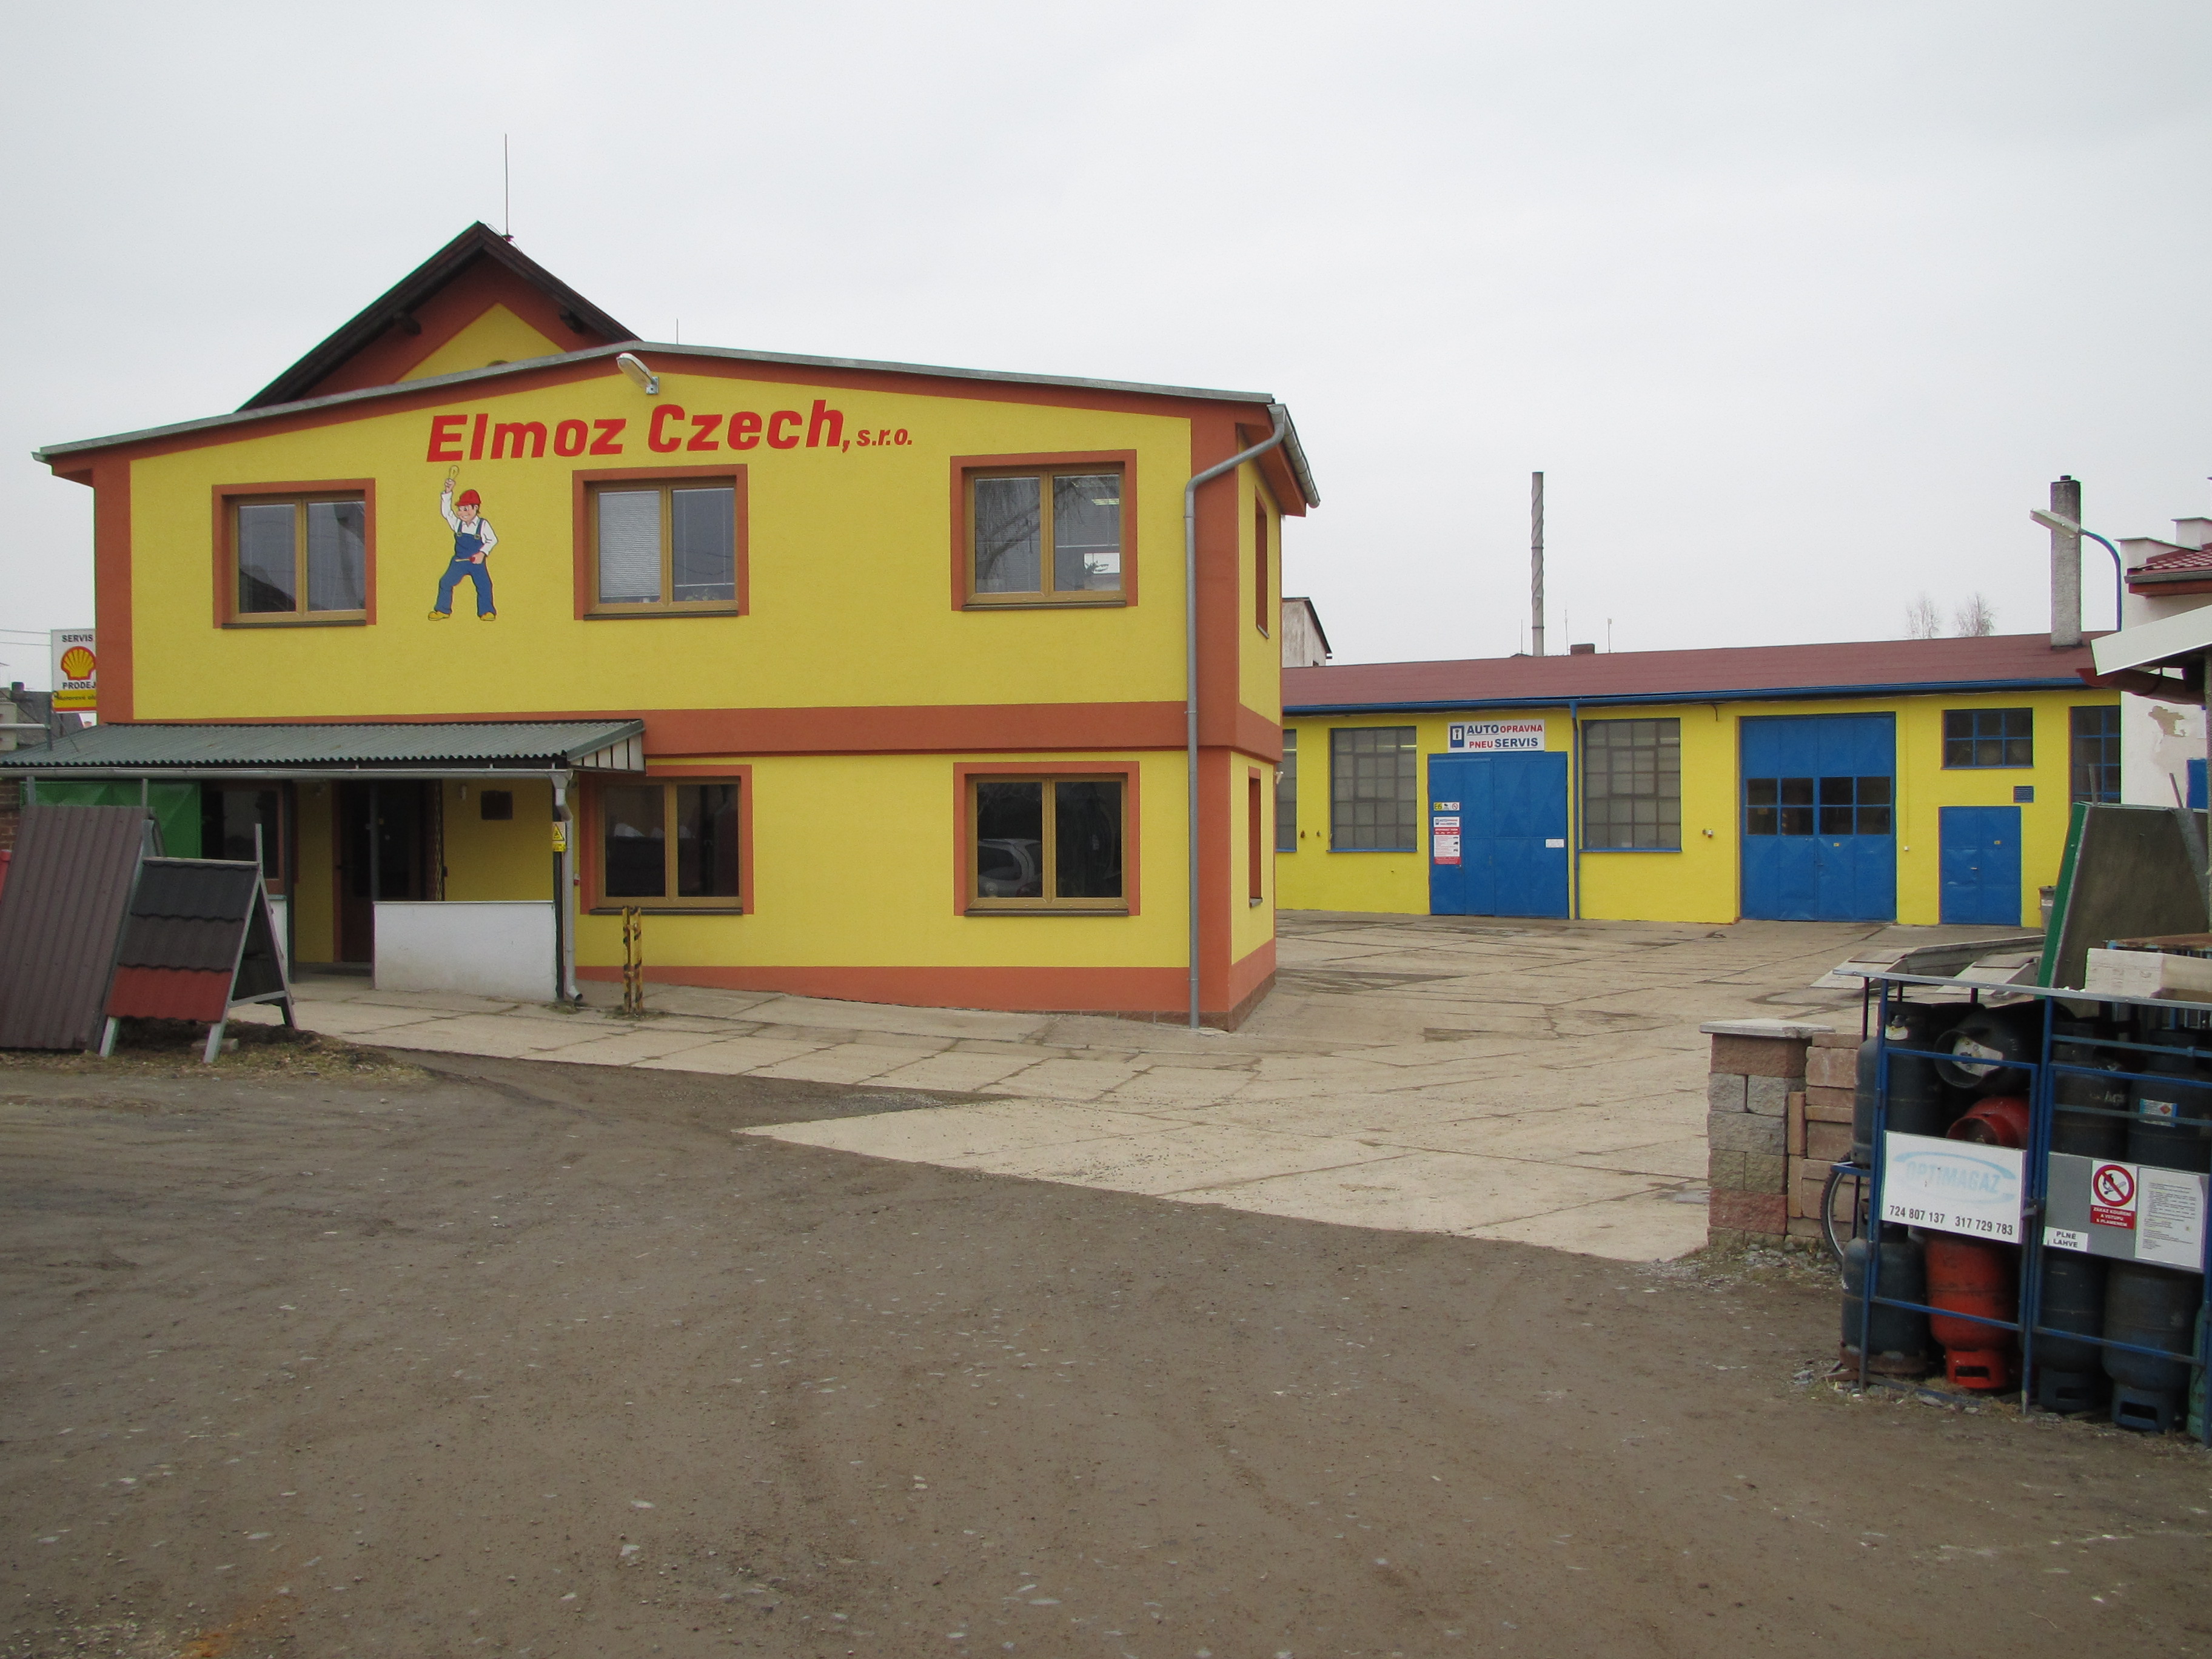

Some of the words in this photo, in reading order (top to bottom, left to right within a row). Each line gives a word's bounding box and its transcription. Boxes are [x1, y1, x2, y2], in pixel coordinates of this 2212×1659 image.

[426, 413, 626, 462] Elmoz
[648, 400, 850, 452] Czech,
[856, 426, 913, 446] s.r.o.
[62, 681, 96, 689] PRODEJ
[1889, 1205, 1906, 1218] 724
[1909, 1208, 1925, 1221] 807
[1929, 1213, 1945, 1224] 137
[1955, 1216, 1972, 1228] 317
[1976, 1219, 1992, 1232] 729
[1996, 1223, 2013, 1235] 783
[2053, 1238, 2078, 1248] LAHVE
